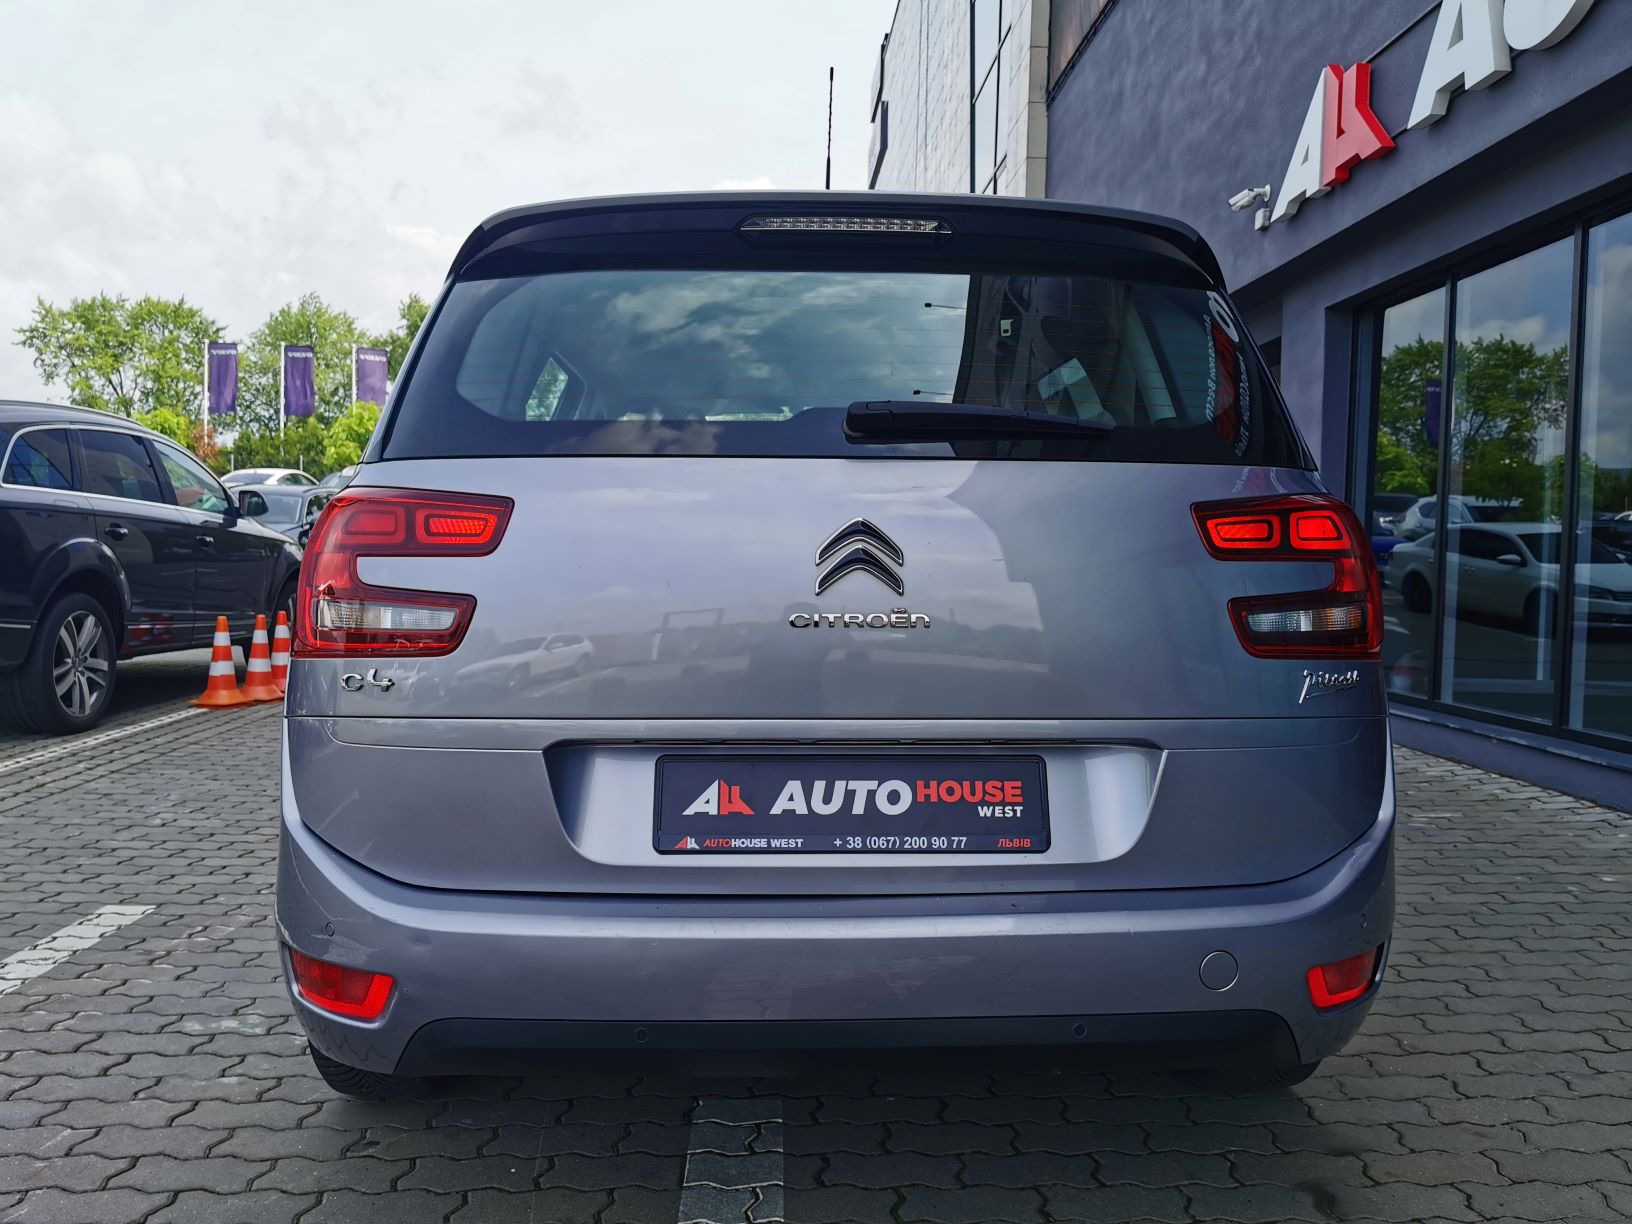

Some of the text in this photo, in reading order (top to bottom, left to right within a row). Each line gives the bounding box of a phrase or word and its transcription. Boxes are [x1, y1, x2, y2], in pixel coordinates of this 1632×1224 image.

[340, 668, 395, 692] C4
[769, 779, 913, 816] AUTO
[916, 780, 1024, 803] HOUSE
[977, 805, 1024, 818] WEST
[770, 838, 804, 848] WEST
[866, 836, 899, 850] (067)
[903, 836, 928, 849] 200
[931, 836, 948, 849] 90
[951, 836, 968, 849] 77
